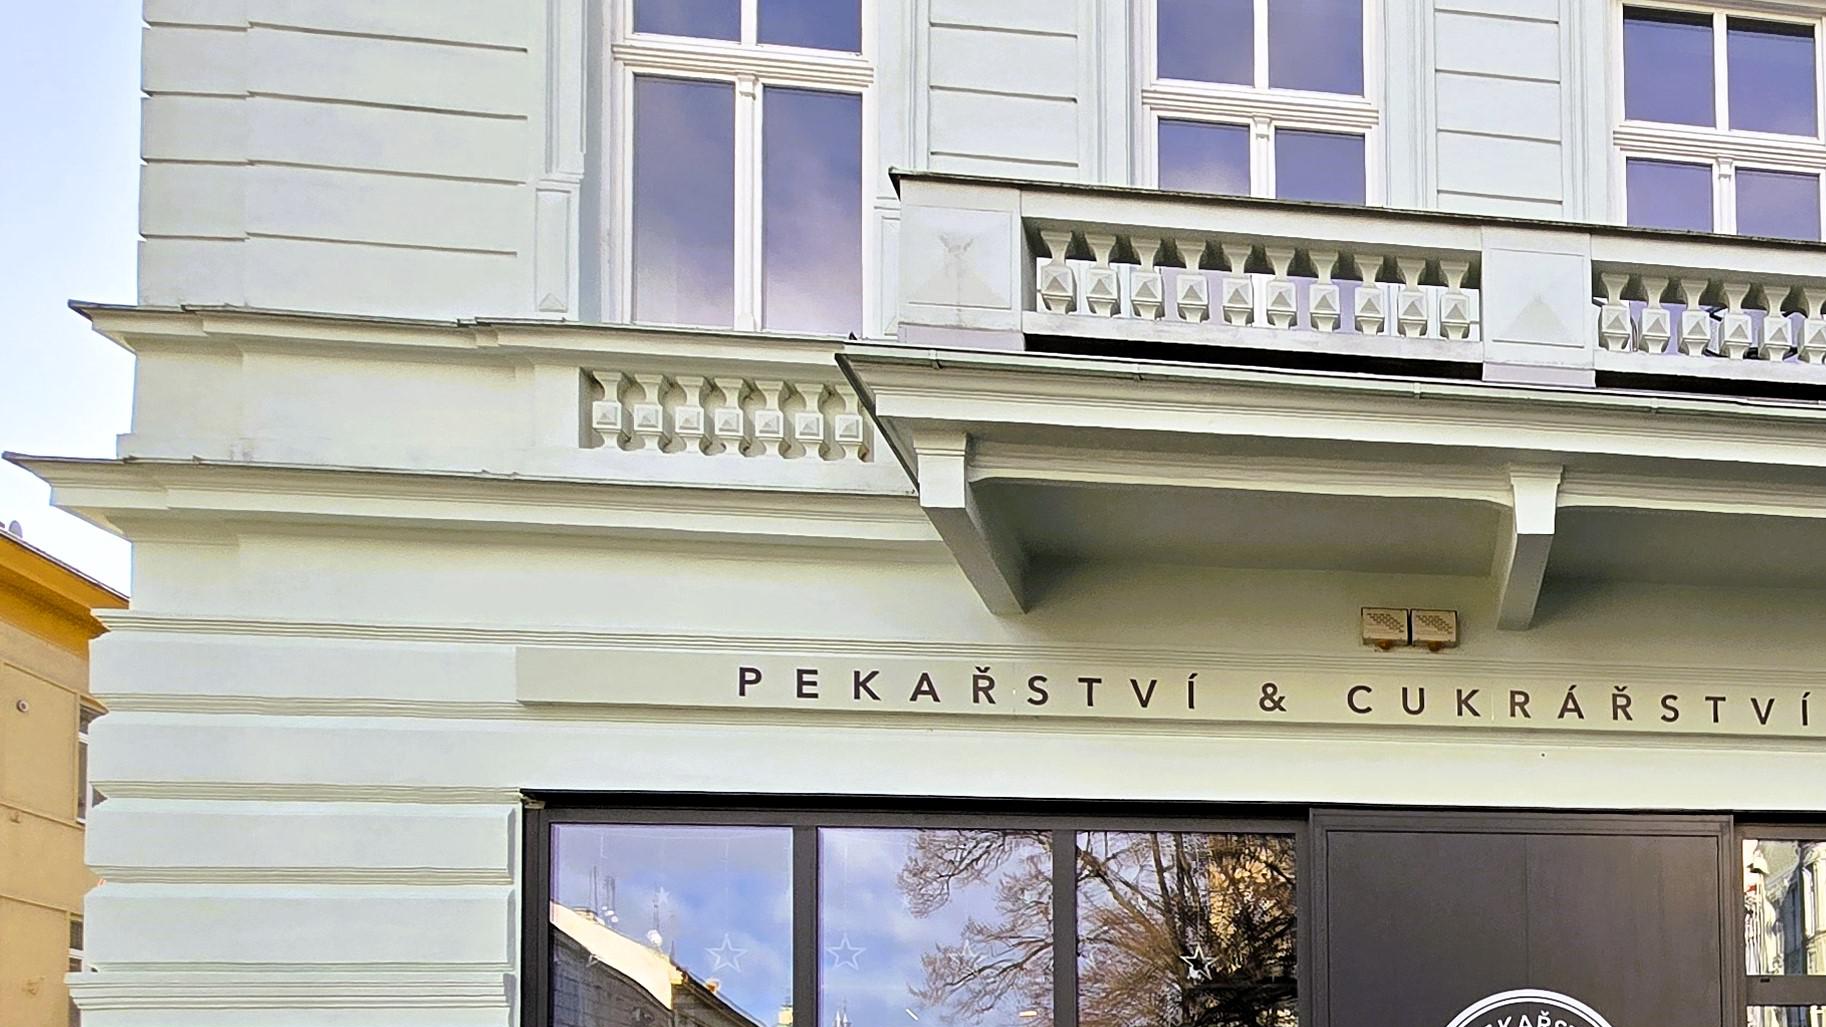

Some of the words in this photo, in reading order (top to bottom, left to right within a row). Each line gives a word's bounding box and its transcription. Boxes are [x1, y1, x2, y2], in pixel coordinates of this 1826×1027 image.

[737, 665, 1197, 711] PEKAŘSTVÍ
[1258, 682, 1287, 712] &
[1346, 683, 1811, 727] CUKRÁŘSTVÍ
